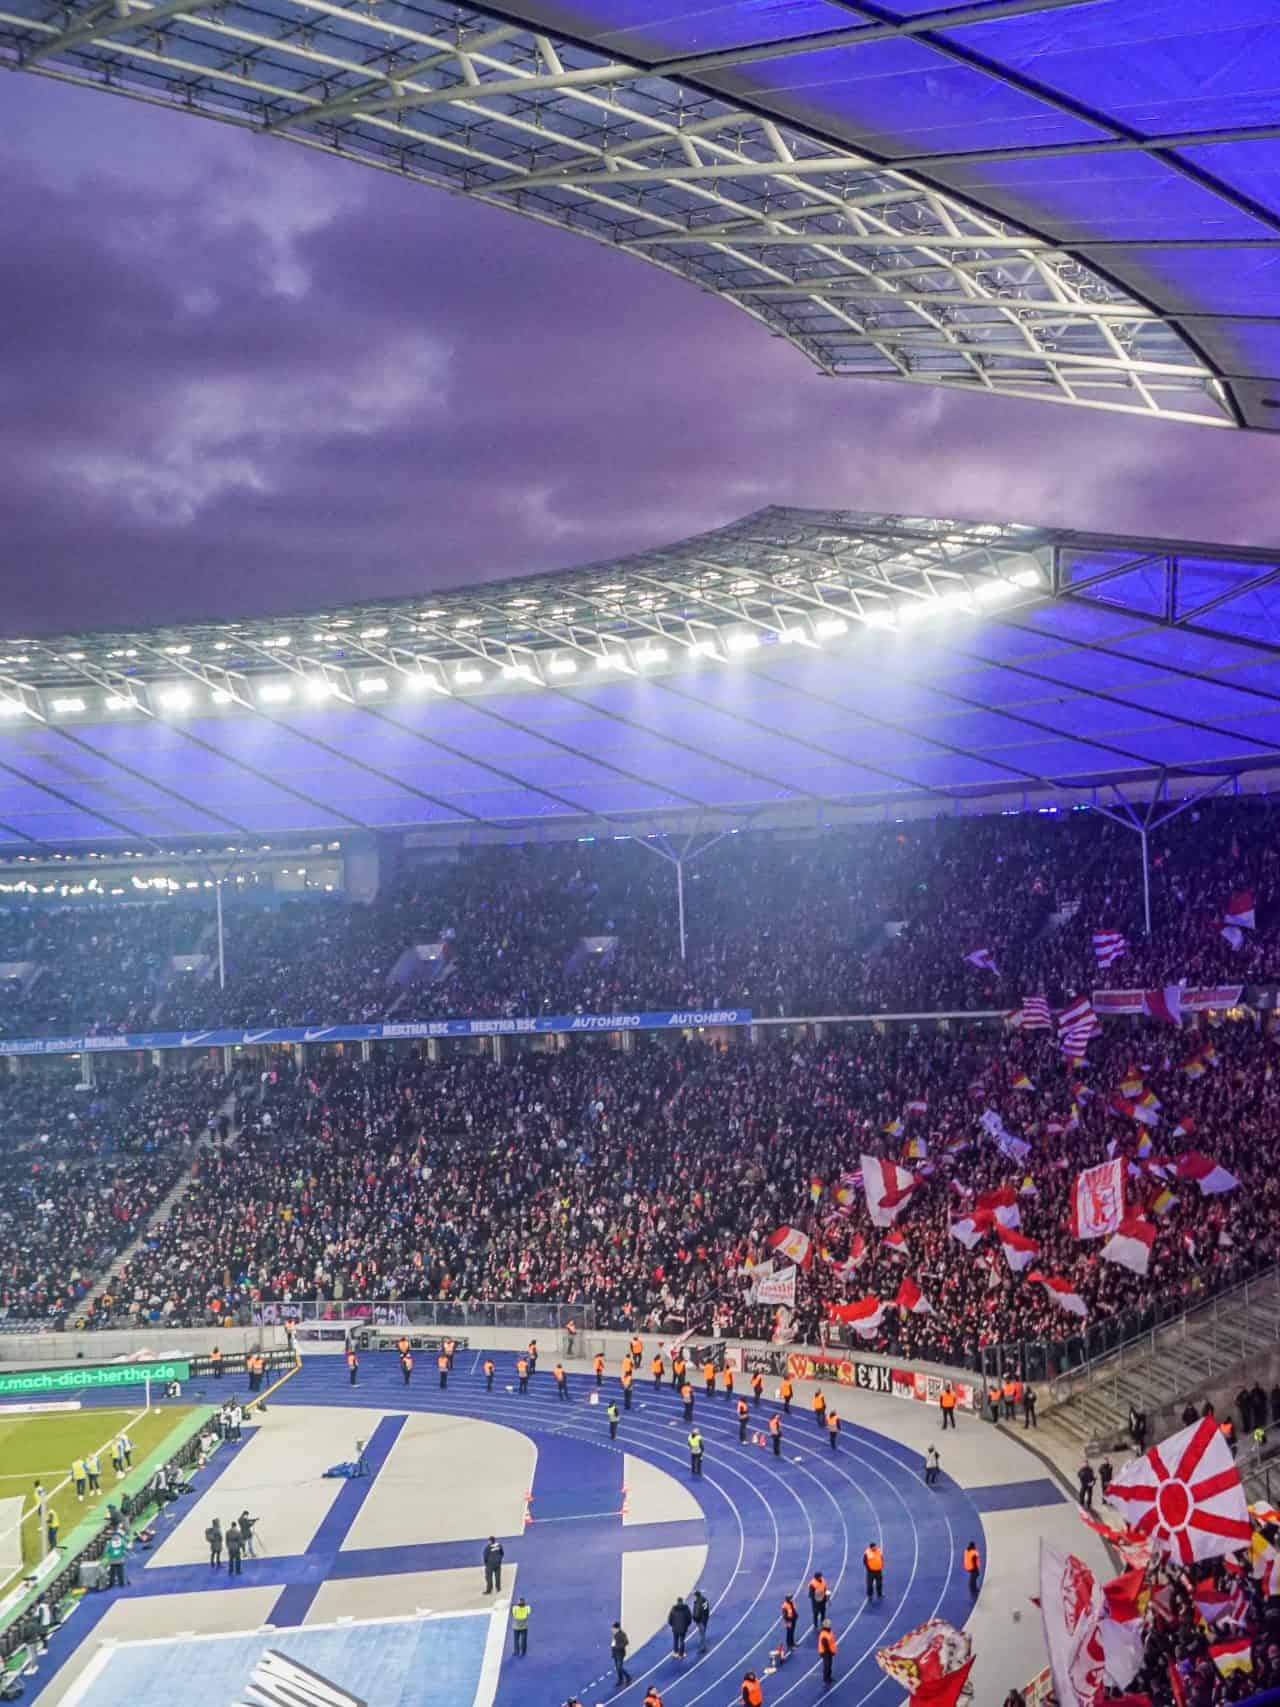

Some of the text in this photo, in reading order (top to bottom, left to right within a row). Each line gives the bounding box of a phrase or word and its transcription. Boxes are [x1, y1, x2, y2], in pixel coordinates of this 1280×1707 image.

[571, 1015, 640, 1028] AUTOHERO
[669, 1011, 737, 1025] AUTOHERO
[383, 1024, 427, 1036] HERTHA
[470, 1020, 515, 1033] HERTHA
